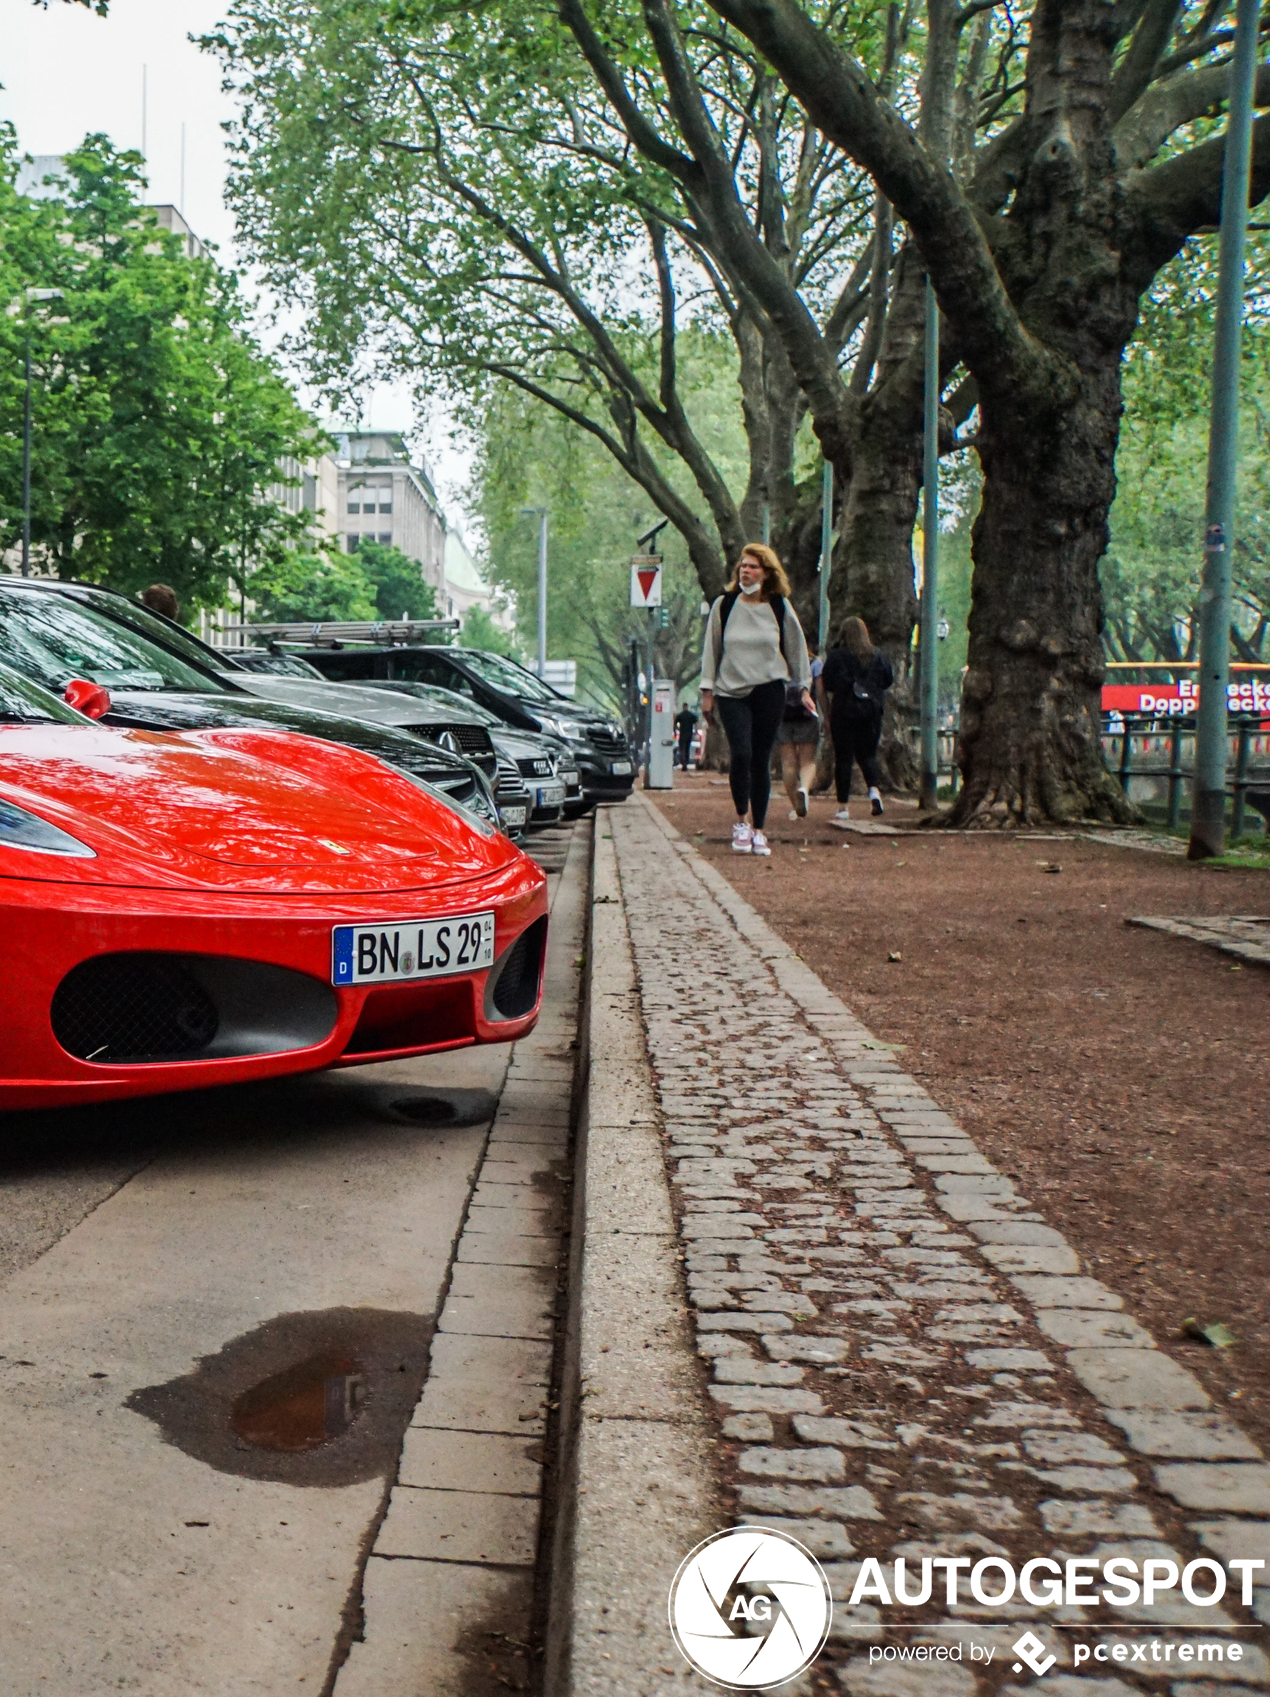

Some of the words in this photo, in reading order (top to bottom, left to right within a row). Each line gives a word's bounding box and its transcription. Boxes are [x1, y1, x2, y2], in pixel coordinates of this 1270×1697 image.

[358, 931, 400, 975] BN
[418, 926, 450, 970] LS
[457, 921, 481, 965] 29
[484, 948, 492, 959] 10
[339, 962, 347, 974] D
